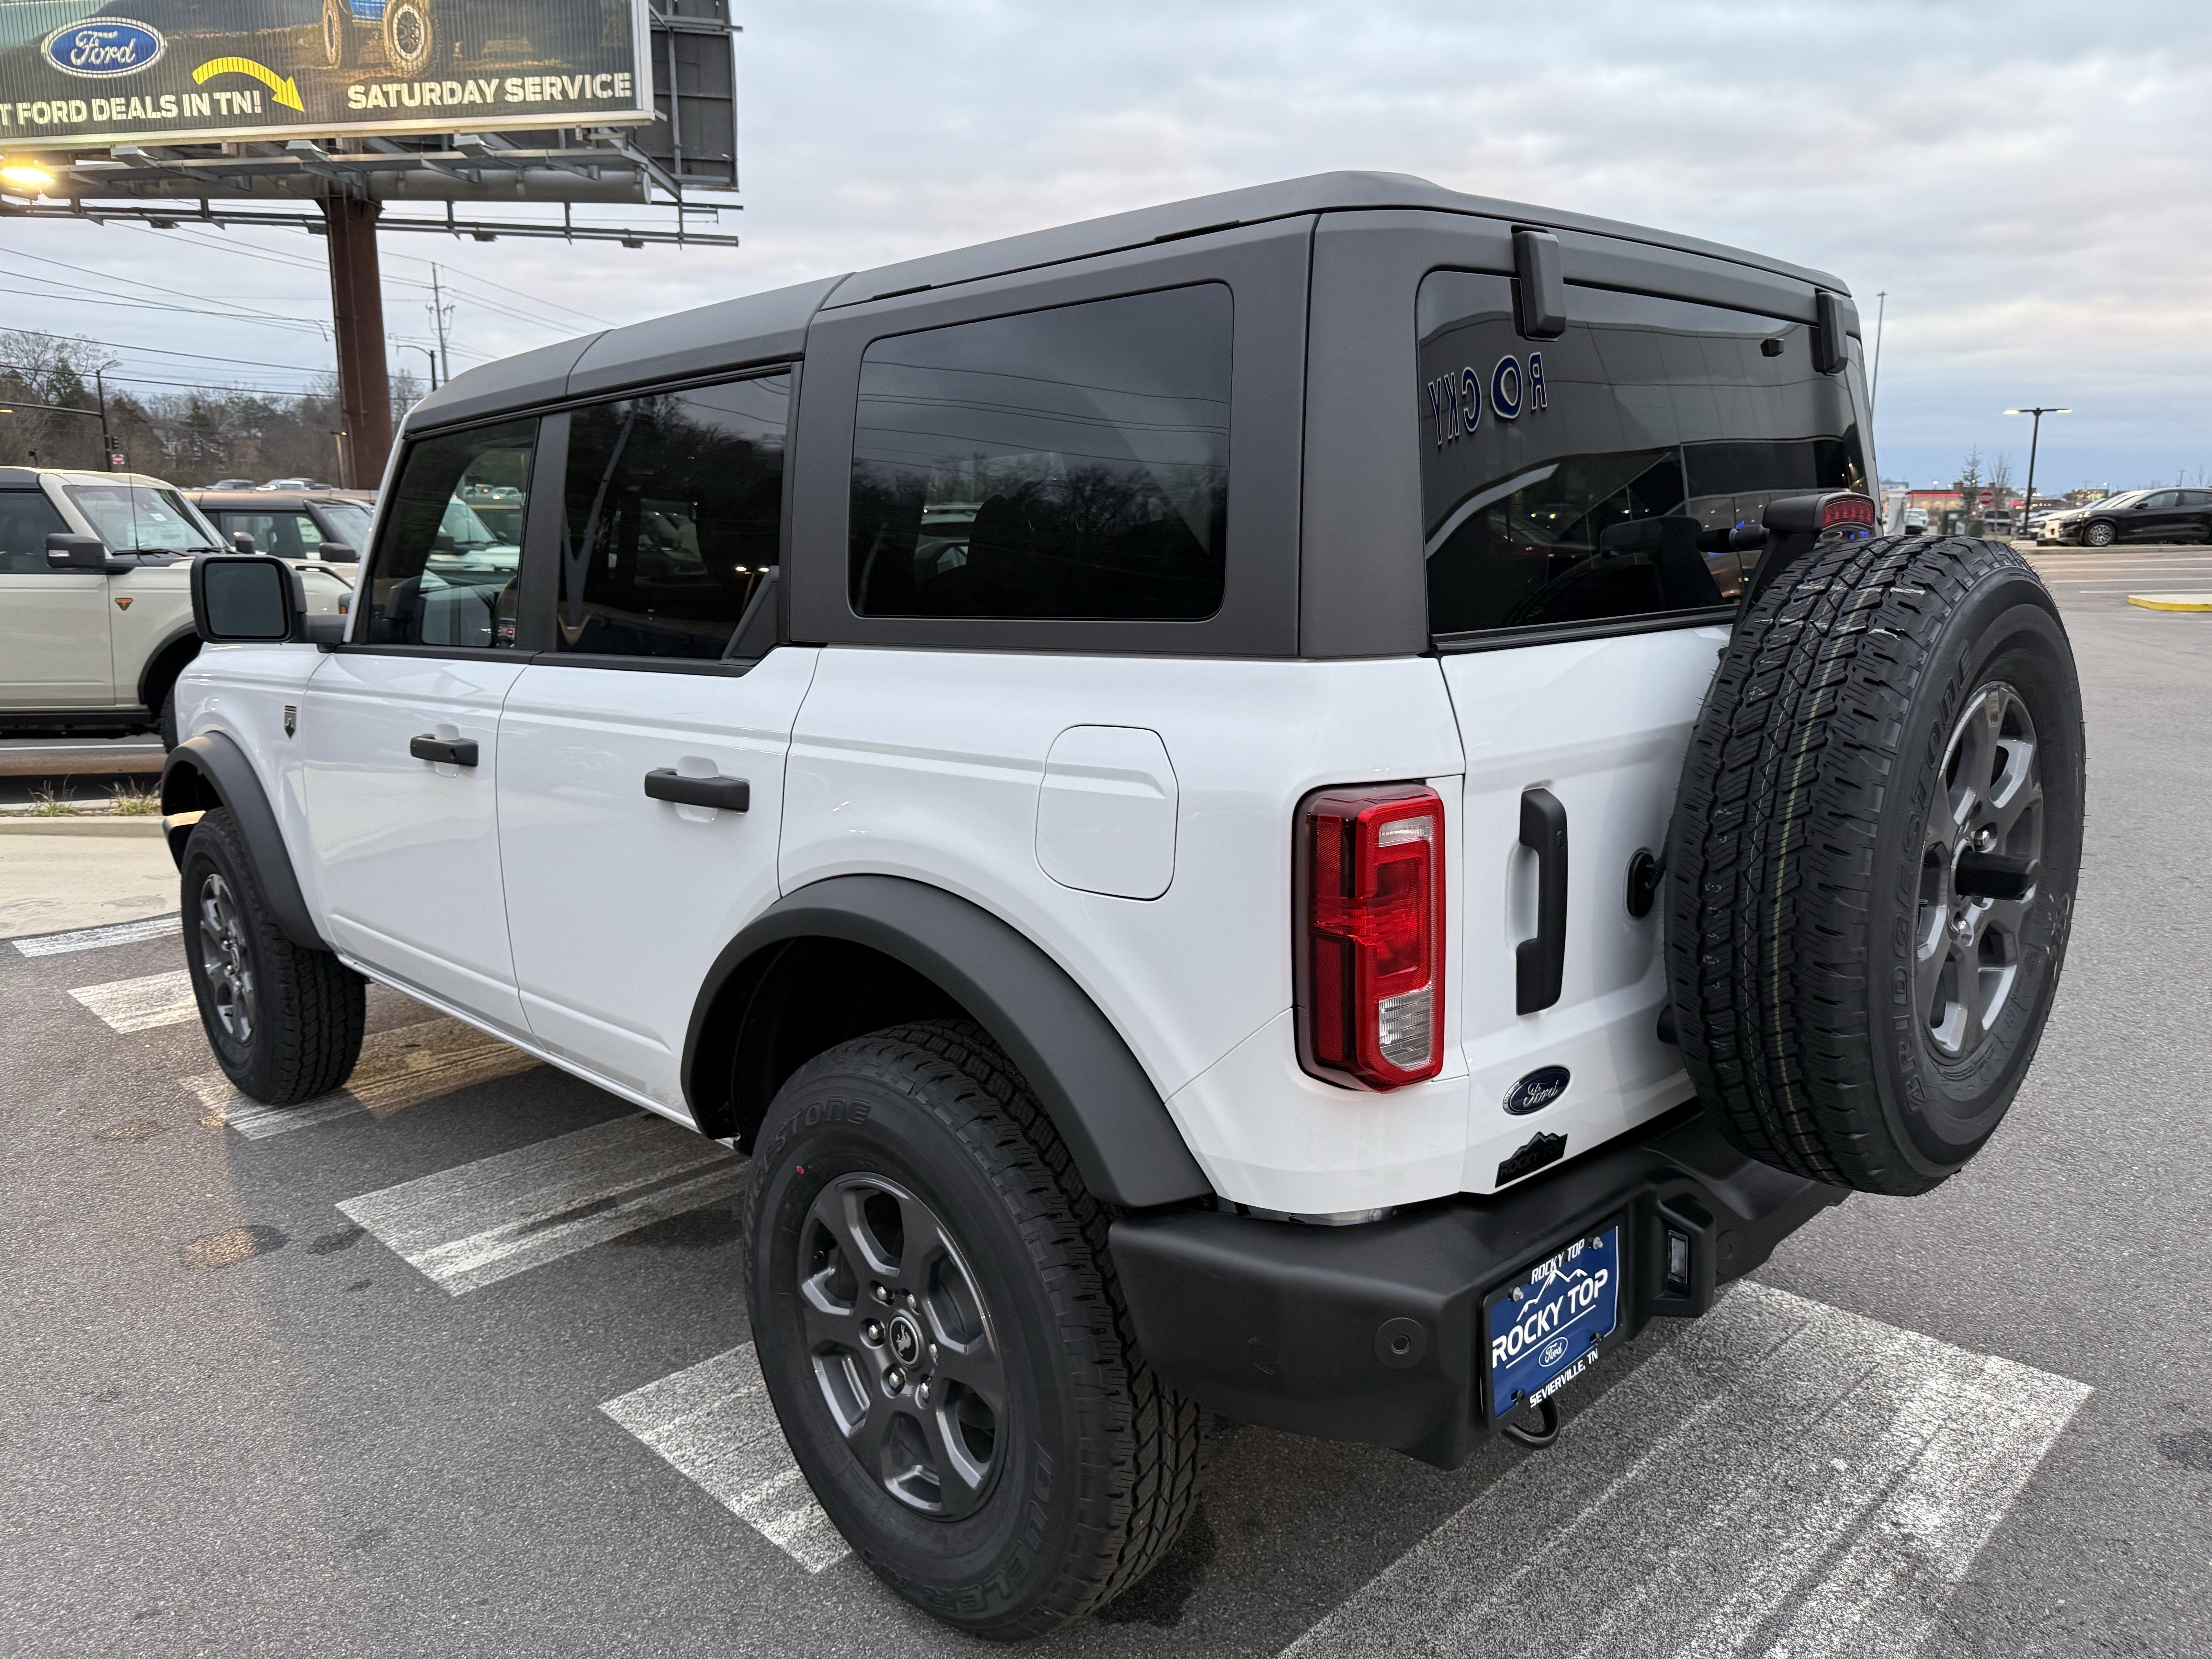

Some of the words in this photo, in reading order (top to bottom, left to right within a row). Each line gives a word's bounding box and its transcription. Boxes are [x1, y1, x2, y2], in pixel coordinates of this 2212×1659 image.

[71, 31, 136, 65] Ford
[17, 100, 87, 124] FORD
[92, 94, 179, 121] DEALS
[182, 93, 211, 117] IN
[213, 90, 261, 114] TN!
[347, 79, 500, 109] SATURDAY
[505, 72, 632, 102] SERVICE
[1523, 1079, 1560, 1108] Ford
[1531, 1251, 1565, 1285] ROCKY
[1567, 1238, 1585, 1261] TOP
[1492, 1295, 1564, 1369] ROCKY
[1567, 1268, 1608, 1315] TOP
[1544, 1341, 1563, 1364] Ford
[1530, 1359, 1586, 1408] SEVIERVILLE,
[1587, 1348, 1599, 1365] TN
